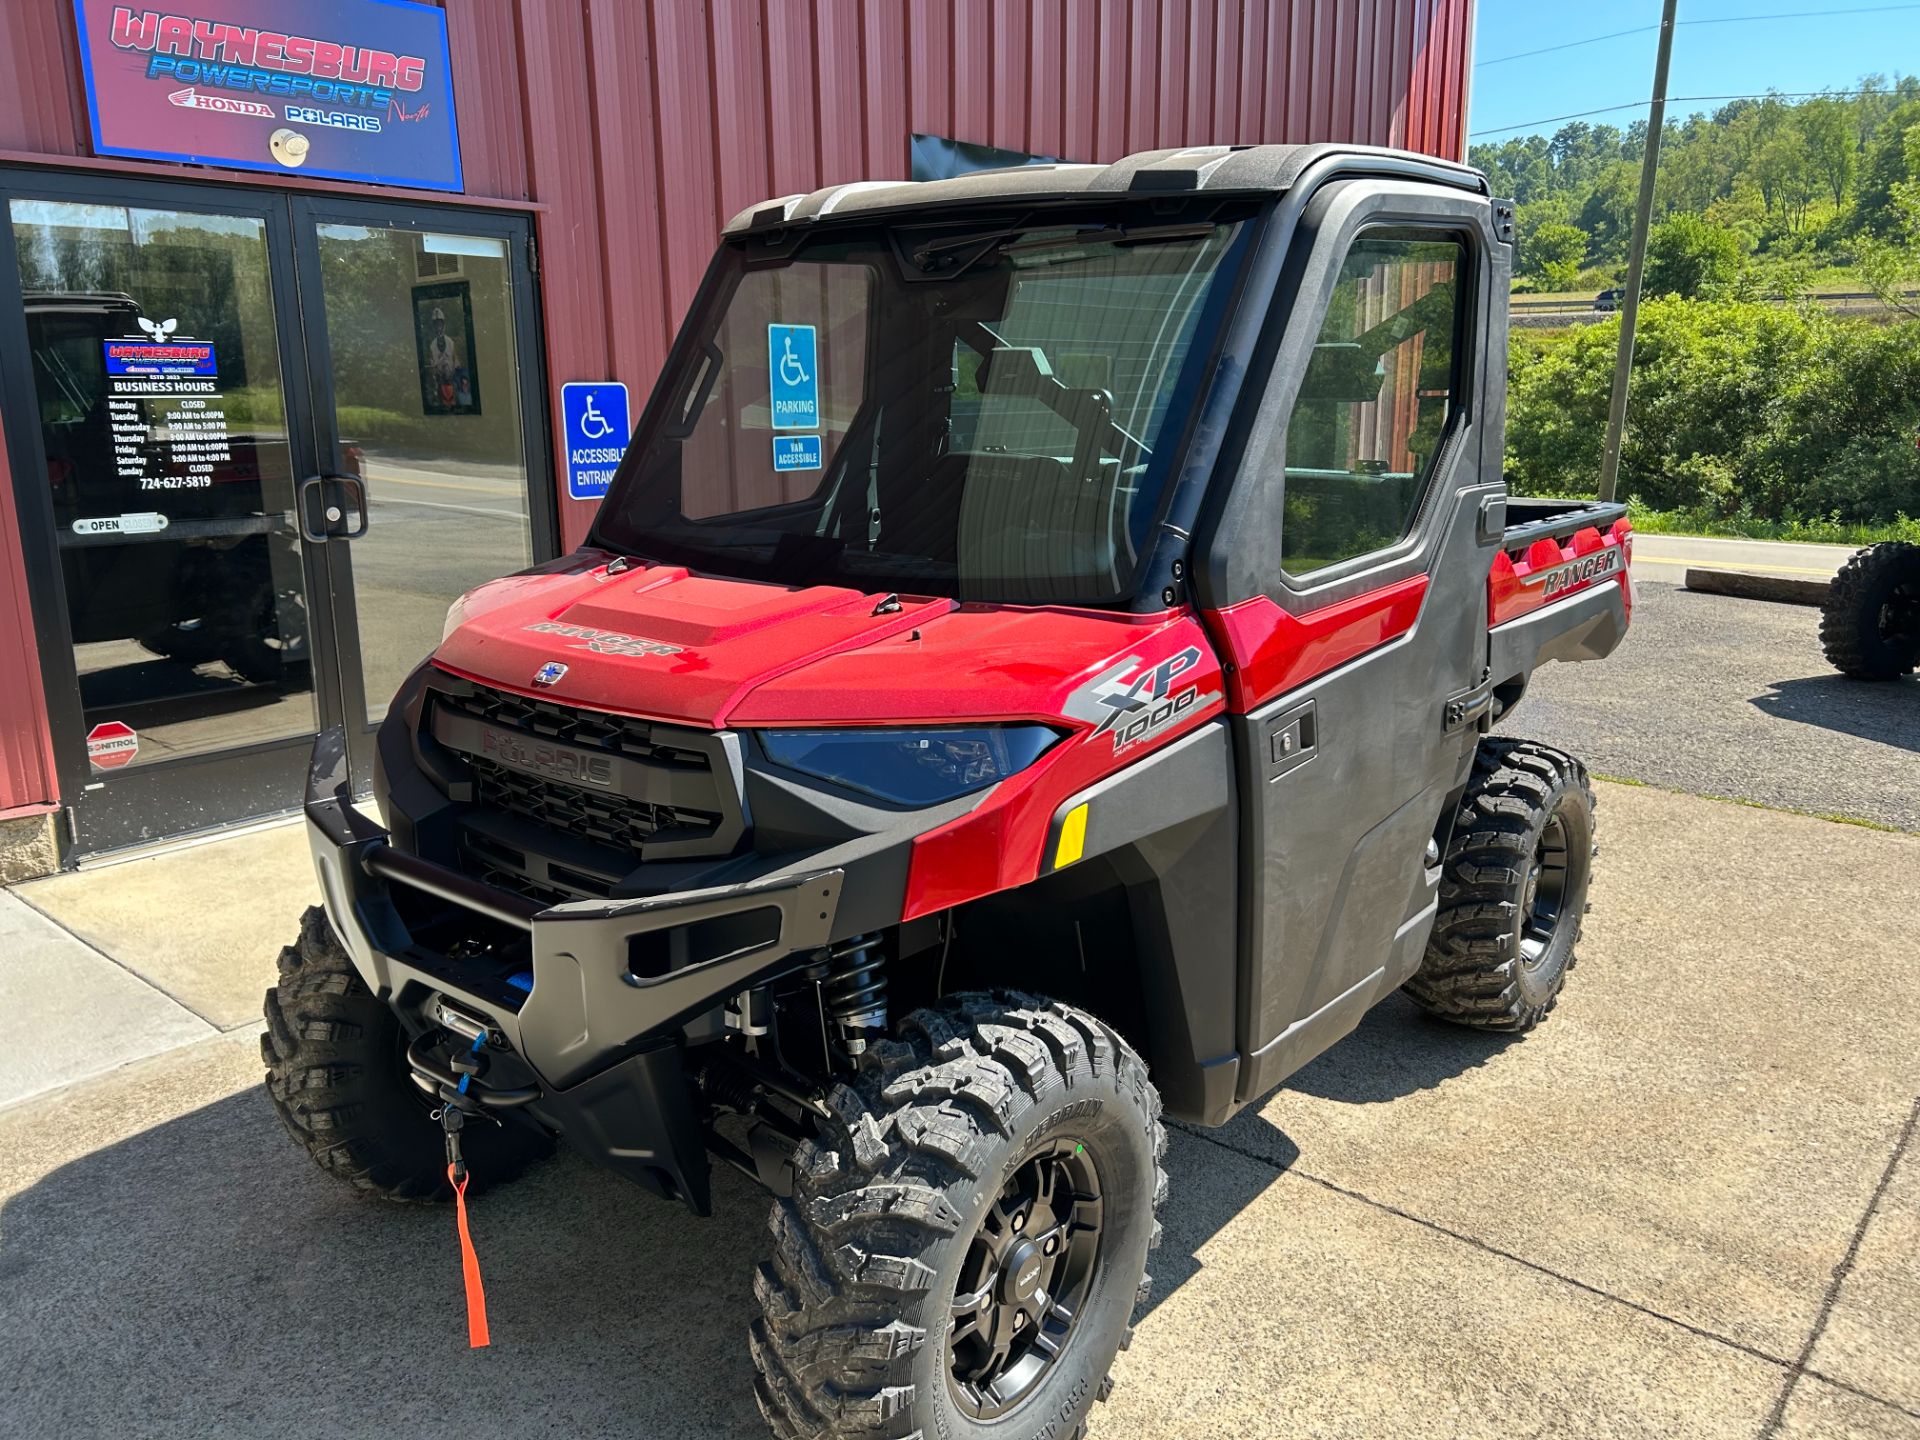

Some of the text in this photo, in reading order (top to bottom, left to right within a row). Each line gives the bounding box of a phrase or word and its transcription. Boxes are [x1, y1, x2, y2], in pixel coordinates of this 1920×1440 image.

[111, 7, 425, 92] WAYNESBURG
[147, 55, 393, 109] POWERSPORTS
[194, 95, 273, 117] HONDA
[287, 107, 380, 131] POLARIS
[109, 346, 210, 358] WAYNESBURG
[114, 382, 216, 392] BUSINESS HOURS
[109, 401, 136, 411] Monday
[776, 400, 814, 413] PARKING
[110, 412, 138, 421] Tuesday
[167, 411, 181, 419] 9:00
[182, 411, 193, 419] AM
[193, 411, 200, 419] to
[112, 423, 151, 432] Wednesday
[168, 422, 182, 430] 9:00
[183, 422, 194, 430] AM
[113, 434, 145, 444] Thursday
[115, 445, 137, 454] Friday
[171, 444, 186, 452] 9:00
[790, 443, 804, 453] VAN
[117, 456, 147, 465] Saturday
[172, 455, 186, 463] 9:00
[187, 454, 197, 462] AM
[198, 454, 205, 462] to
[220, 453, 231, 461] PM
[778, 453, 817, 465] ACCESSIBLE
[118, 467, 143, 476] Sunday
[140, 476, 211, 489] 724-627-5819
[91, 520, 119, 530] OPEN
[1542, 550, 1616, 597] RANGER
[522, 622, 684, 655] RANGER
[1082, 645, 1202, 745] XP
[1113, 684, 1197, 752] 1000
[88, 739, 136, 752] SONITROL
[482, 727, 611, 786] POLARIS
